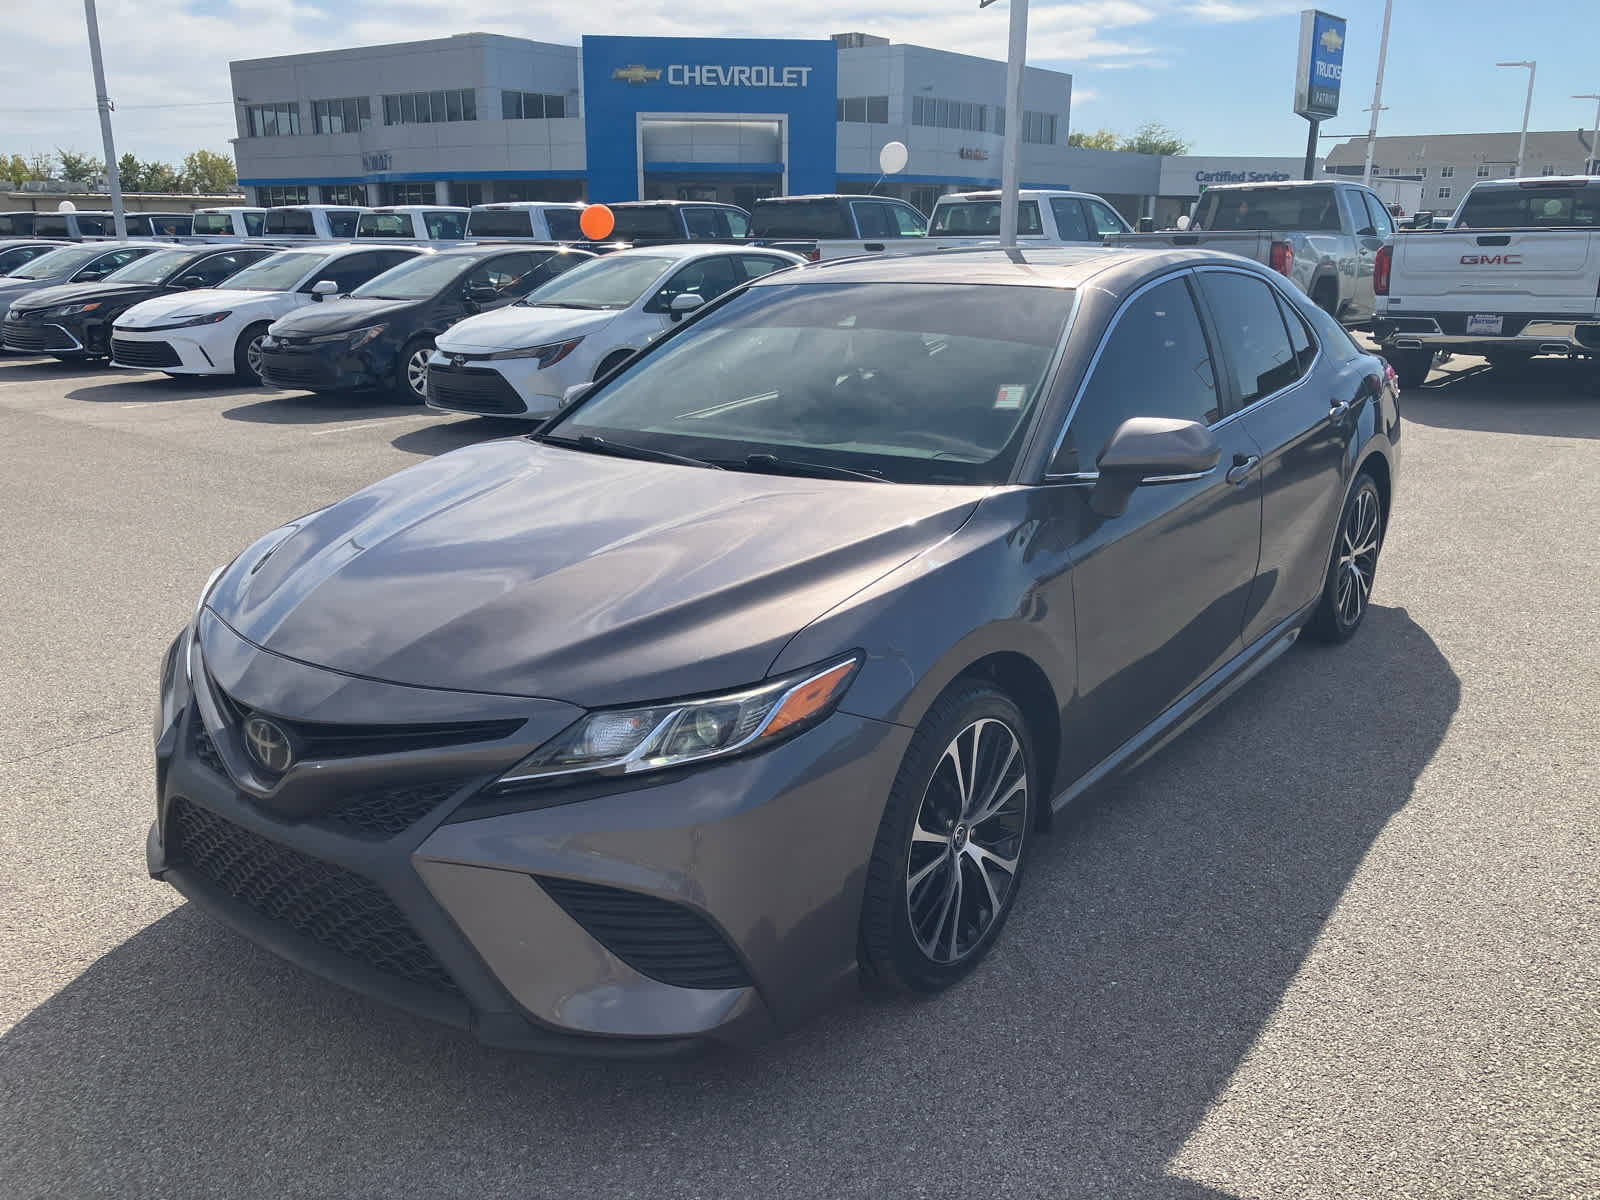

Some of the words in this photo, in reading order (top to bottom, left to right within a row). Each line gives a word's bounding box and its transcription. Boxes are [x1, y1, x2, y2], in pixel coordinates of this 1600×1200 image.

[667, 64, 812, 87] CHEVROLET
[1315, 60, 1342, 79] TRUCKS
[1195, 171, 1246, 182] Certified
[1249, 171, 1290, 182] Service
[1460, 254, 1523, 265] GMC
